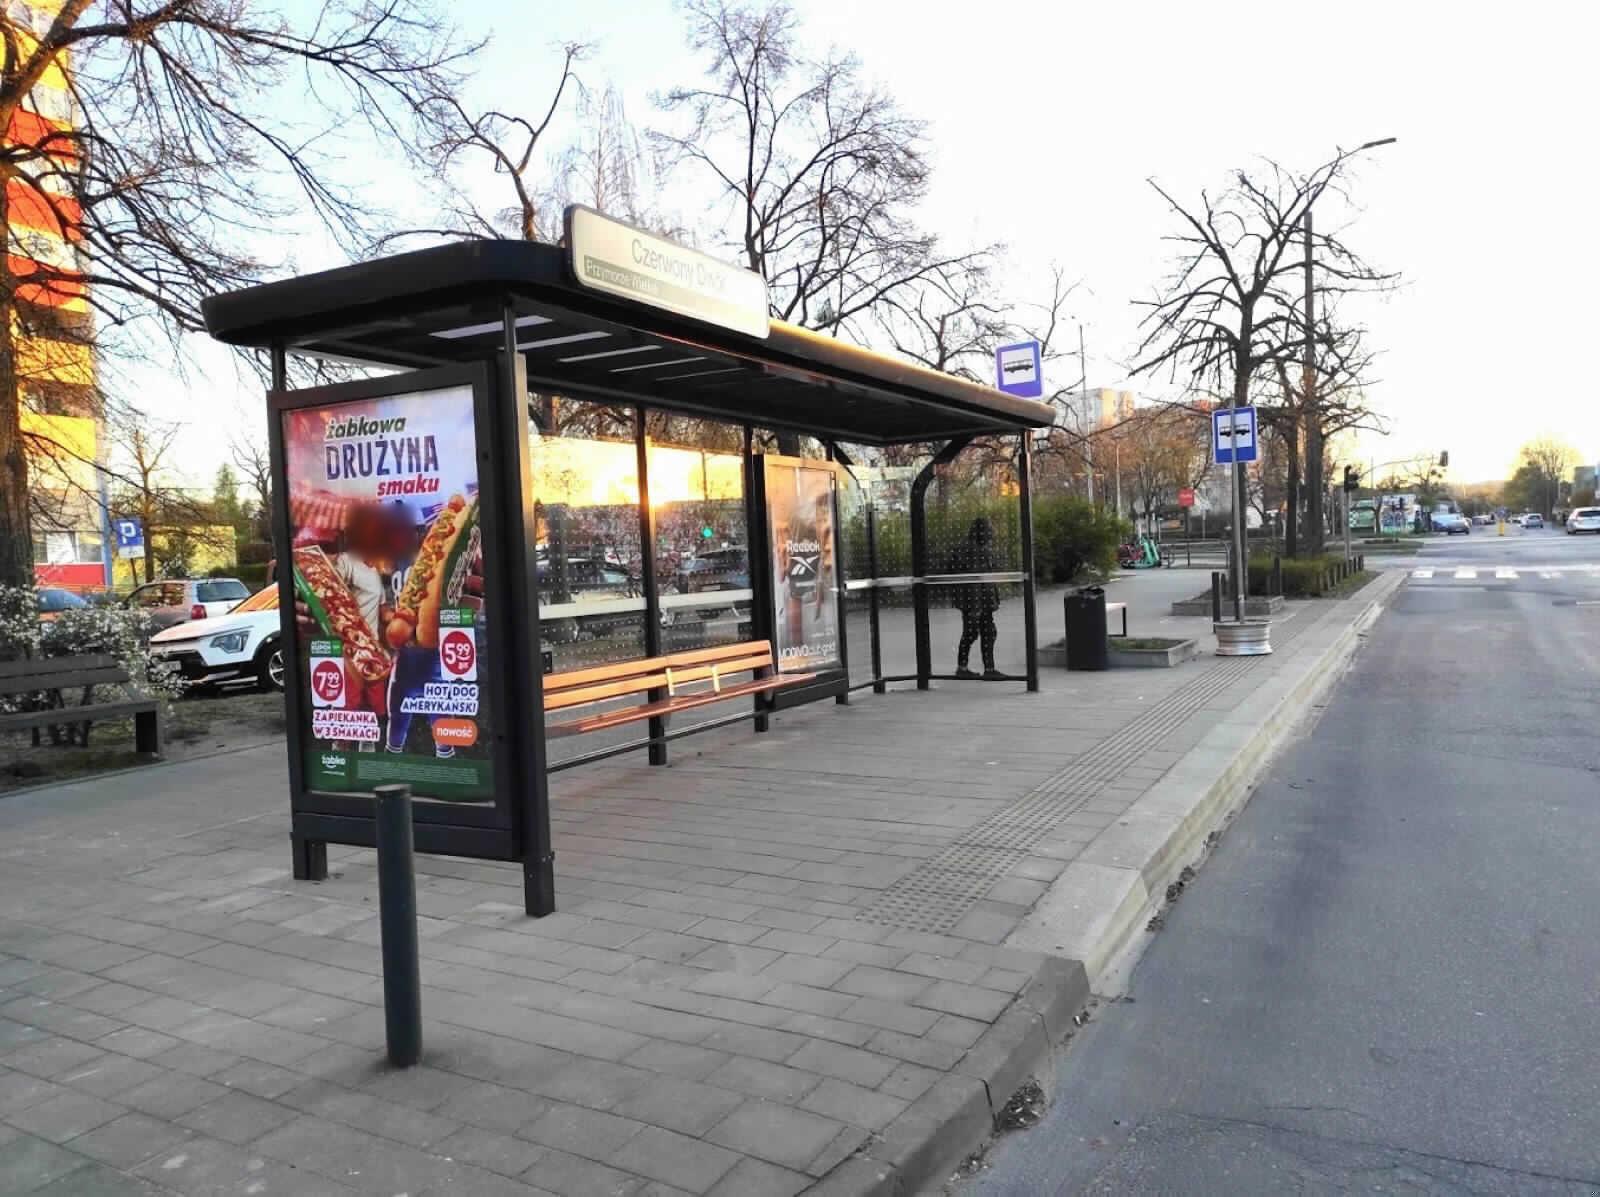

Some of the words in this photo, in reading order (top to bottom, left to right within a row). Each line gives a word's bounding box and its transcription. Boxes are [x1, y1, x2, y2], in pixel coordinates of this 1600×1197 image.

[631, 238, 693, 287] Czerwony
[325, 416, 406, 439] żabkowa
[326, 434, 440, 480] DRUŻYNA
[377, 473, 440, 496] smaku
[425, 685, 449, 697] HOT
[452, 686, 477, 698] DOG
[314, 711, 377, 725] ZAPIEKANKA
[314, 726, 323, 736] W
[332, 727, 379, 740] SMAKACH
[436, 725, 474, 739] nowość
